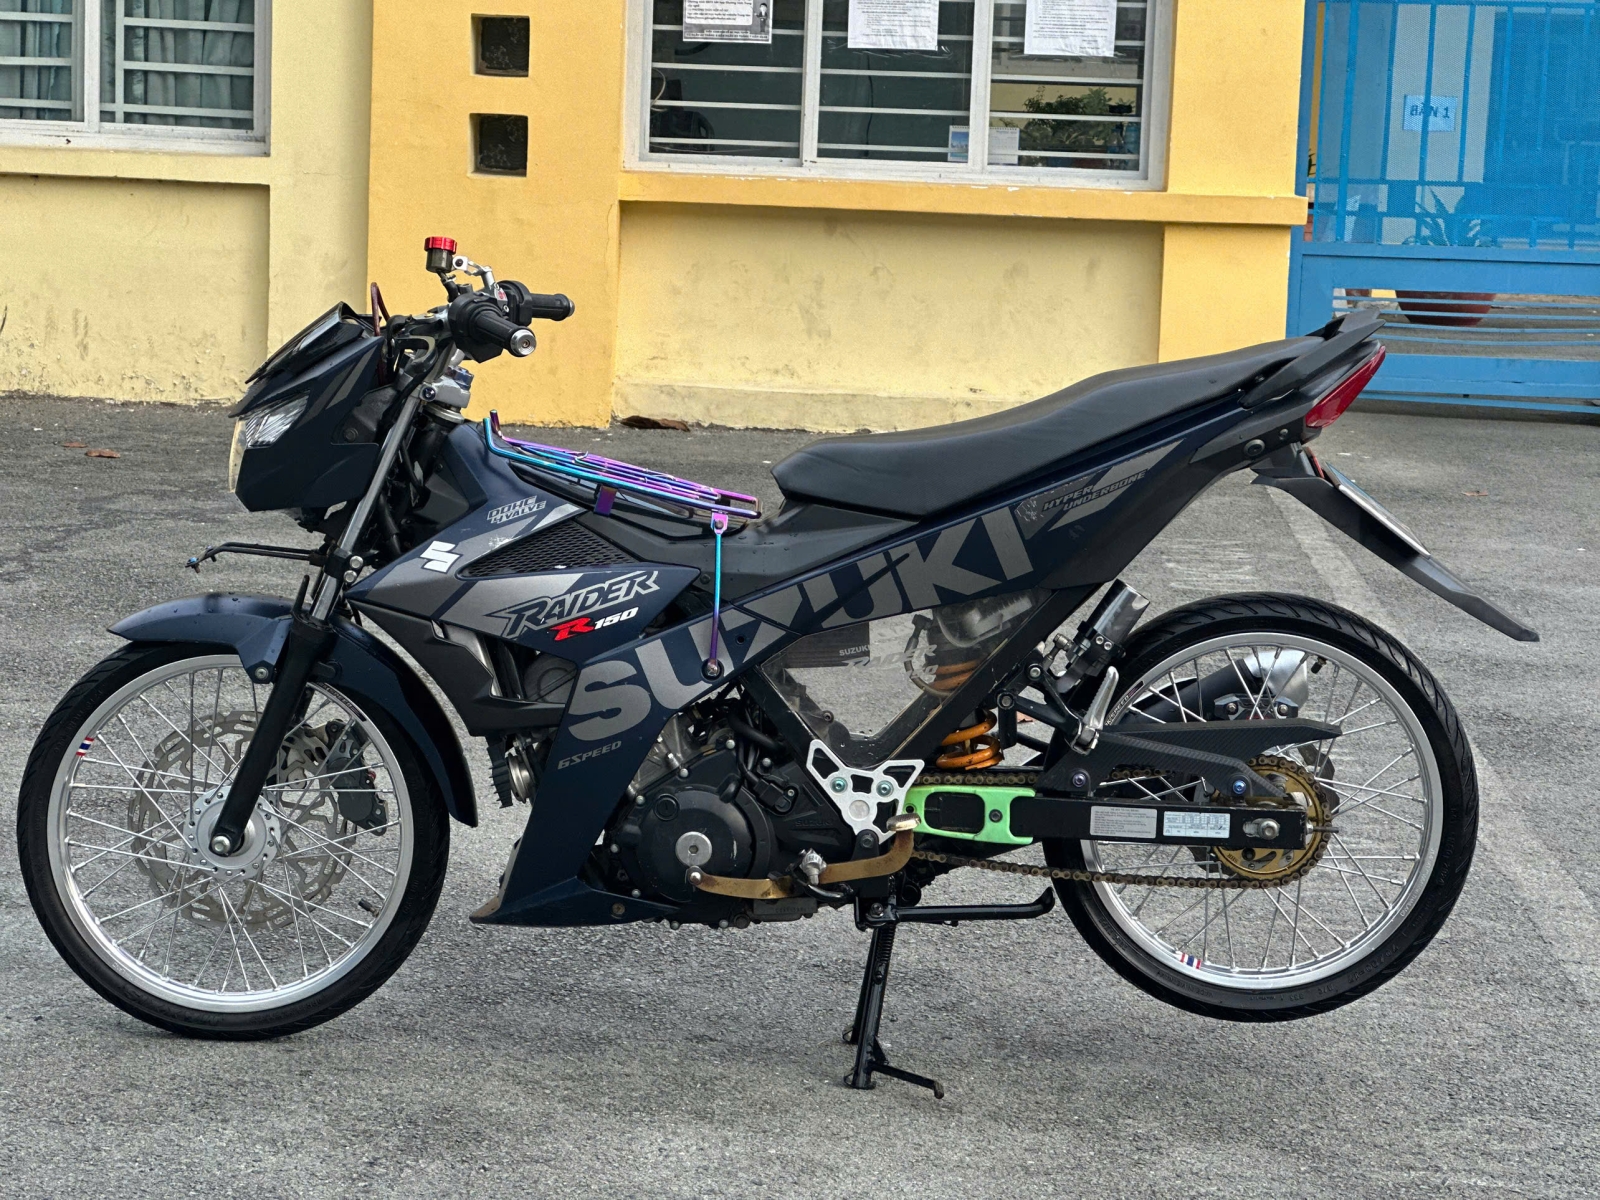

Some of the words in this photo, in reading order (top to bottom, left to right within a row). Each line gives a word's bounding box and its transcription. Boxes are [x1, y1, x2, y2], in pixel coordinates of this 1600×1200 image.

[1443, 106, 1450, 119] 1
[1042, 485, 1094, 512] HYPER
[1063, 470, 1146, 511] UNDERBONE
[483, 570, 661, 641] RAIDER
[568, 506, 1034, 742] SUZUKI
